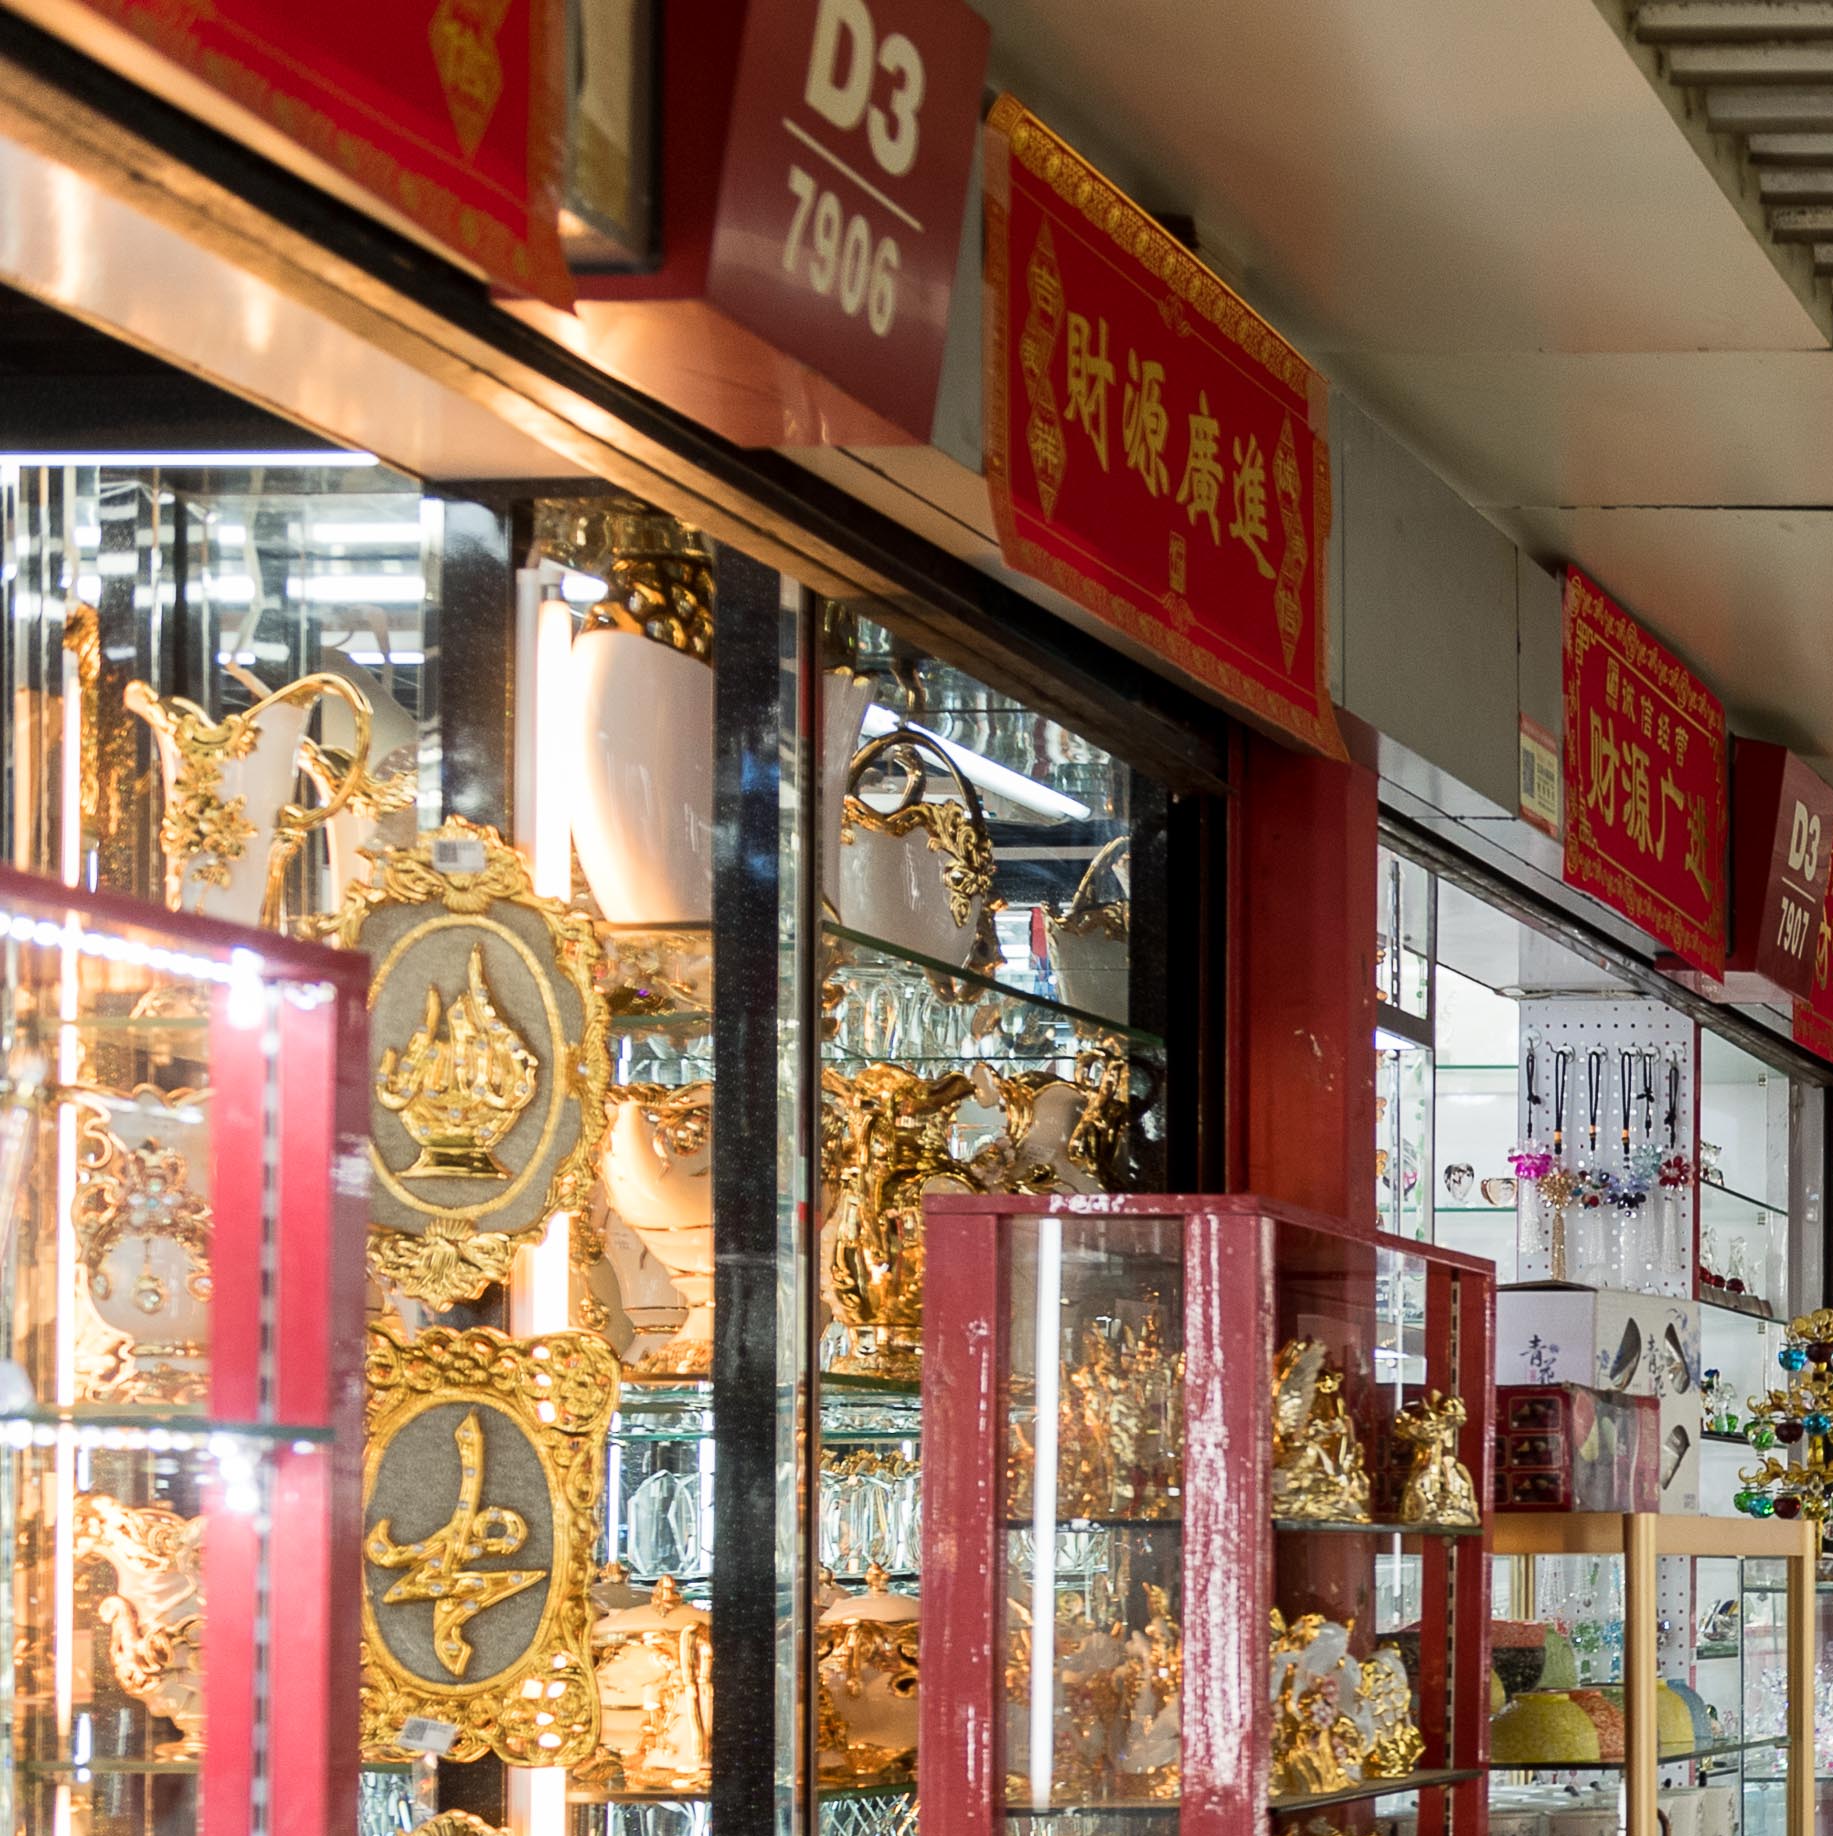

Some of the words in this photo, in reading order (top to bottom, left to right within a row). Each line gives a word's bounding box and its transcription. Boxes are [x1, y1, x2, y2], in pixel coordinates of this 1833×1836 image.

[804, 0, 927, 177] D3
[781, 163, 900, 338] 7906
[1063, 309, 1277, 580] 財源廣進
[1586, 704, 1713, 901] 财源广进
[1621, 676, 1690, 768] 诚信经营
[1776, 895, 1811, 961] 7907
[1787, 799, 1821, 882] D3
